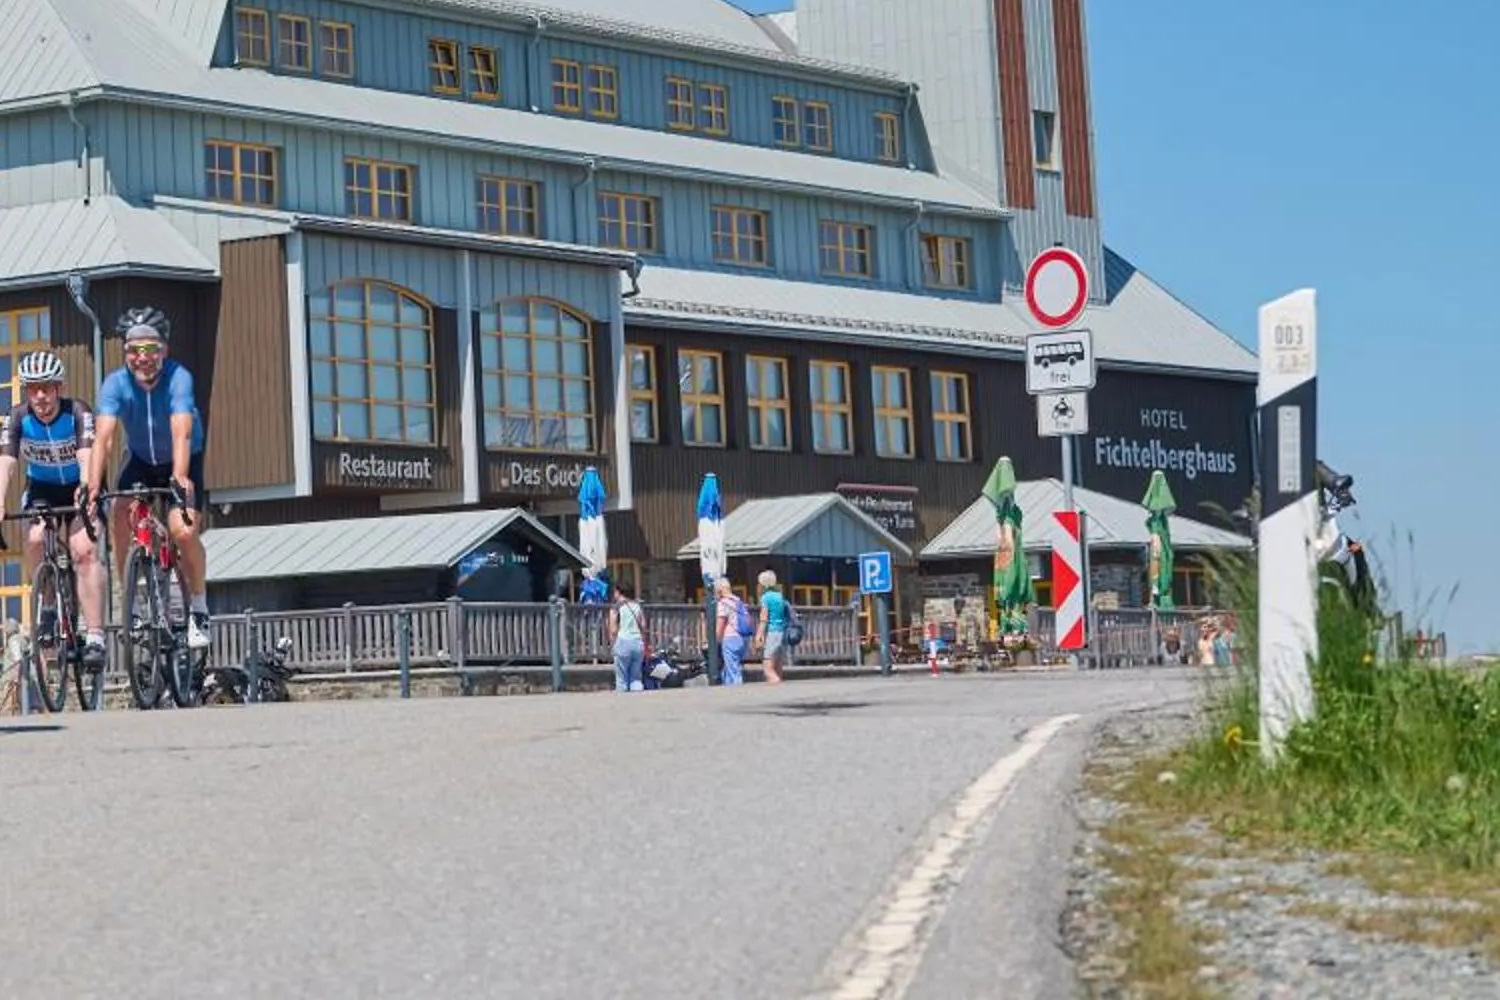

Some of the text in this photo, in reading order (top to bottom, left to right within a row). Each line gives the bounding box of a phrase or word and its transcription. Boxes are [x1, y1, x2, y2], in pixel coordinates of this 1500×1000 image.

[1274, 324, 1303, 345] 003
[1140, 408, 1187, 430] HOTEL
[340, 452, 432, 480] Restaurant
[1095, 436, 1237, 480] Fichtelberghaus
[510, 462, 541, 486] Das
[864, 559, 881, 588] P
